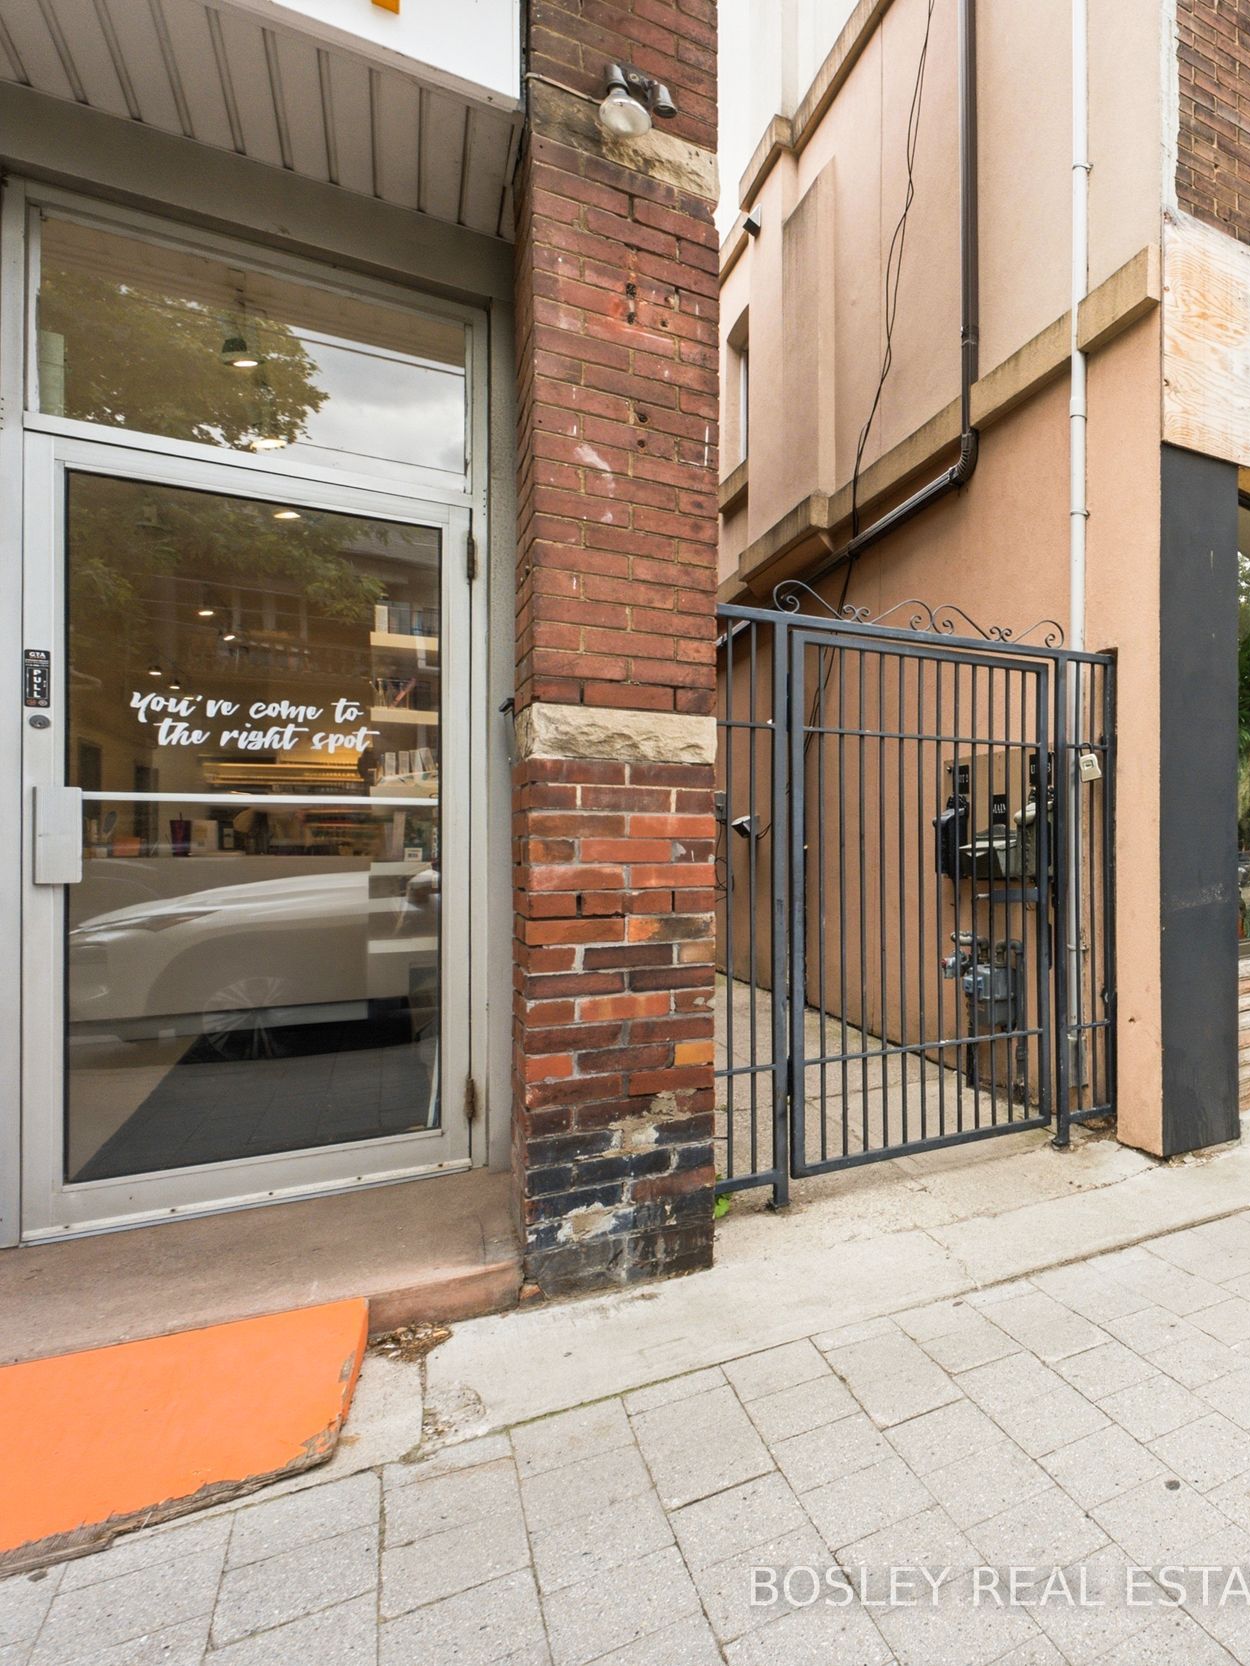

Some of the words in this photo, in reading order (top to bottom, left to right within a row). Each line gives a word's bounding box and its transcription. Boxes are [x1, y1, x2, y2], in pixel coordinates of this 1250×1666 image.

[33, 669, 42, 698] PULL
[130, 691, 240, 723] You've
[249, 700, 323, 722] come
[331, 698, 364, 723] to
[153, 718, 210, 746] the
[219, 723, 309, 750] right
[310, 727, 380, 754] spot
